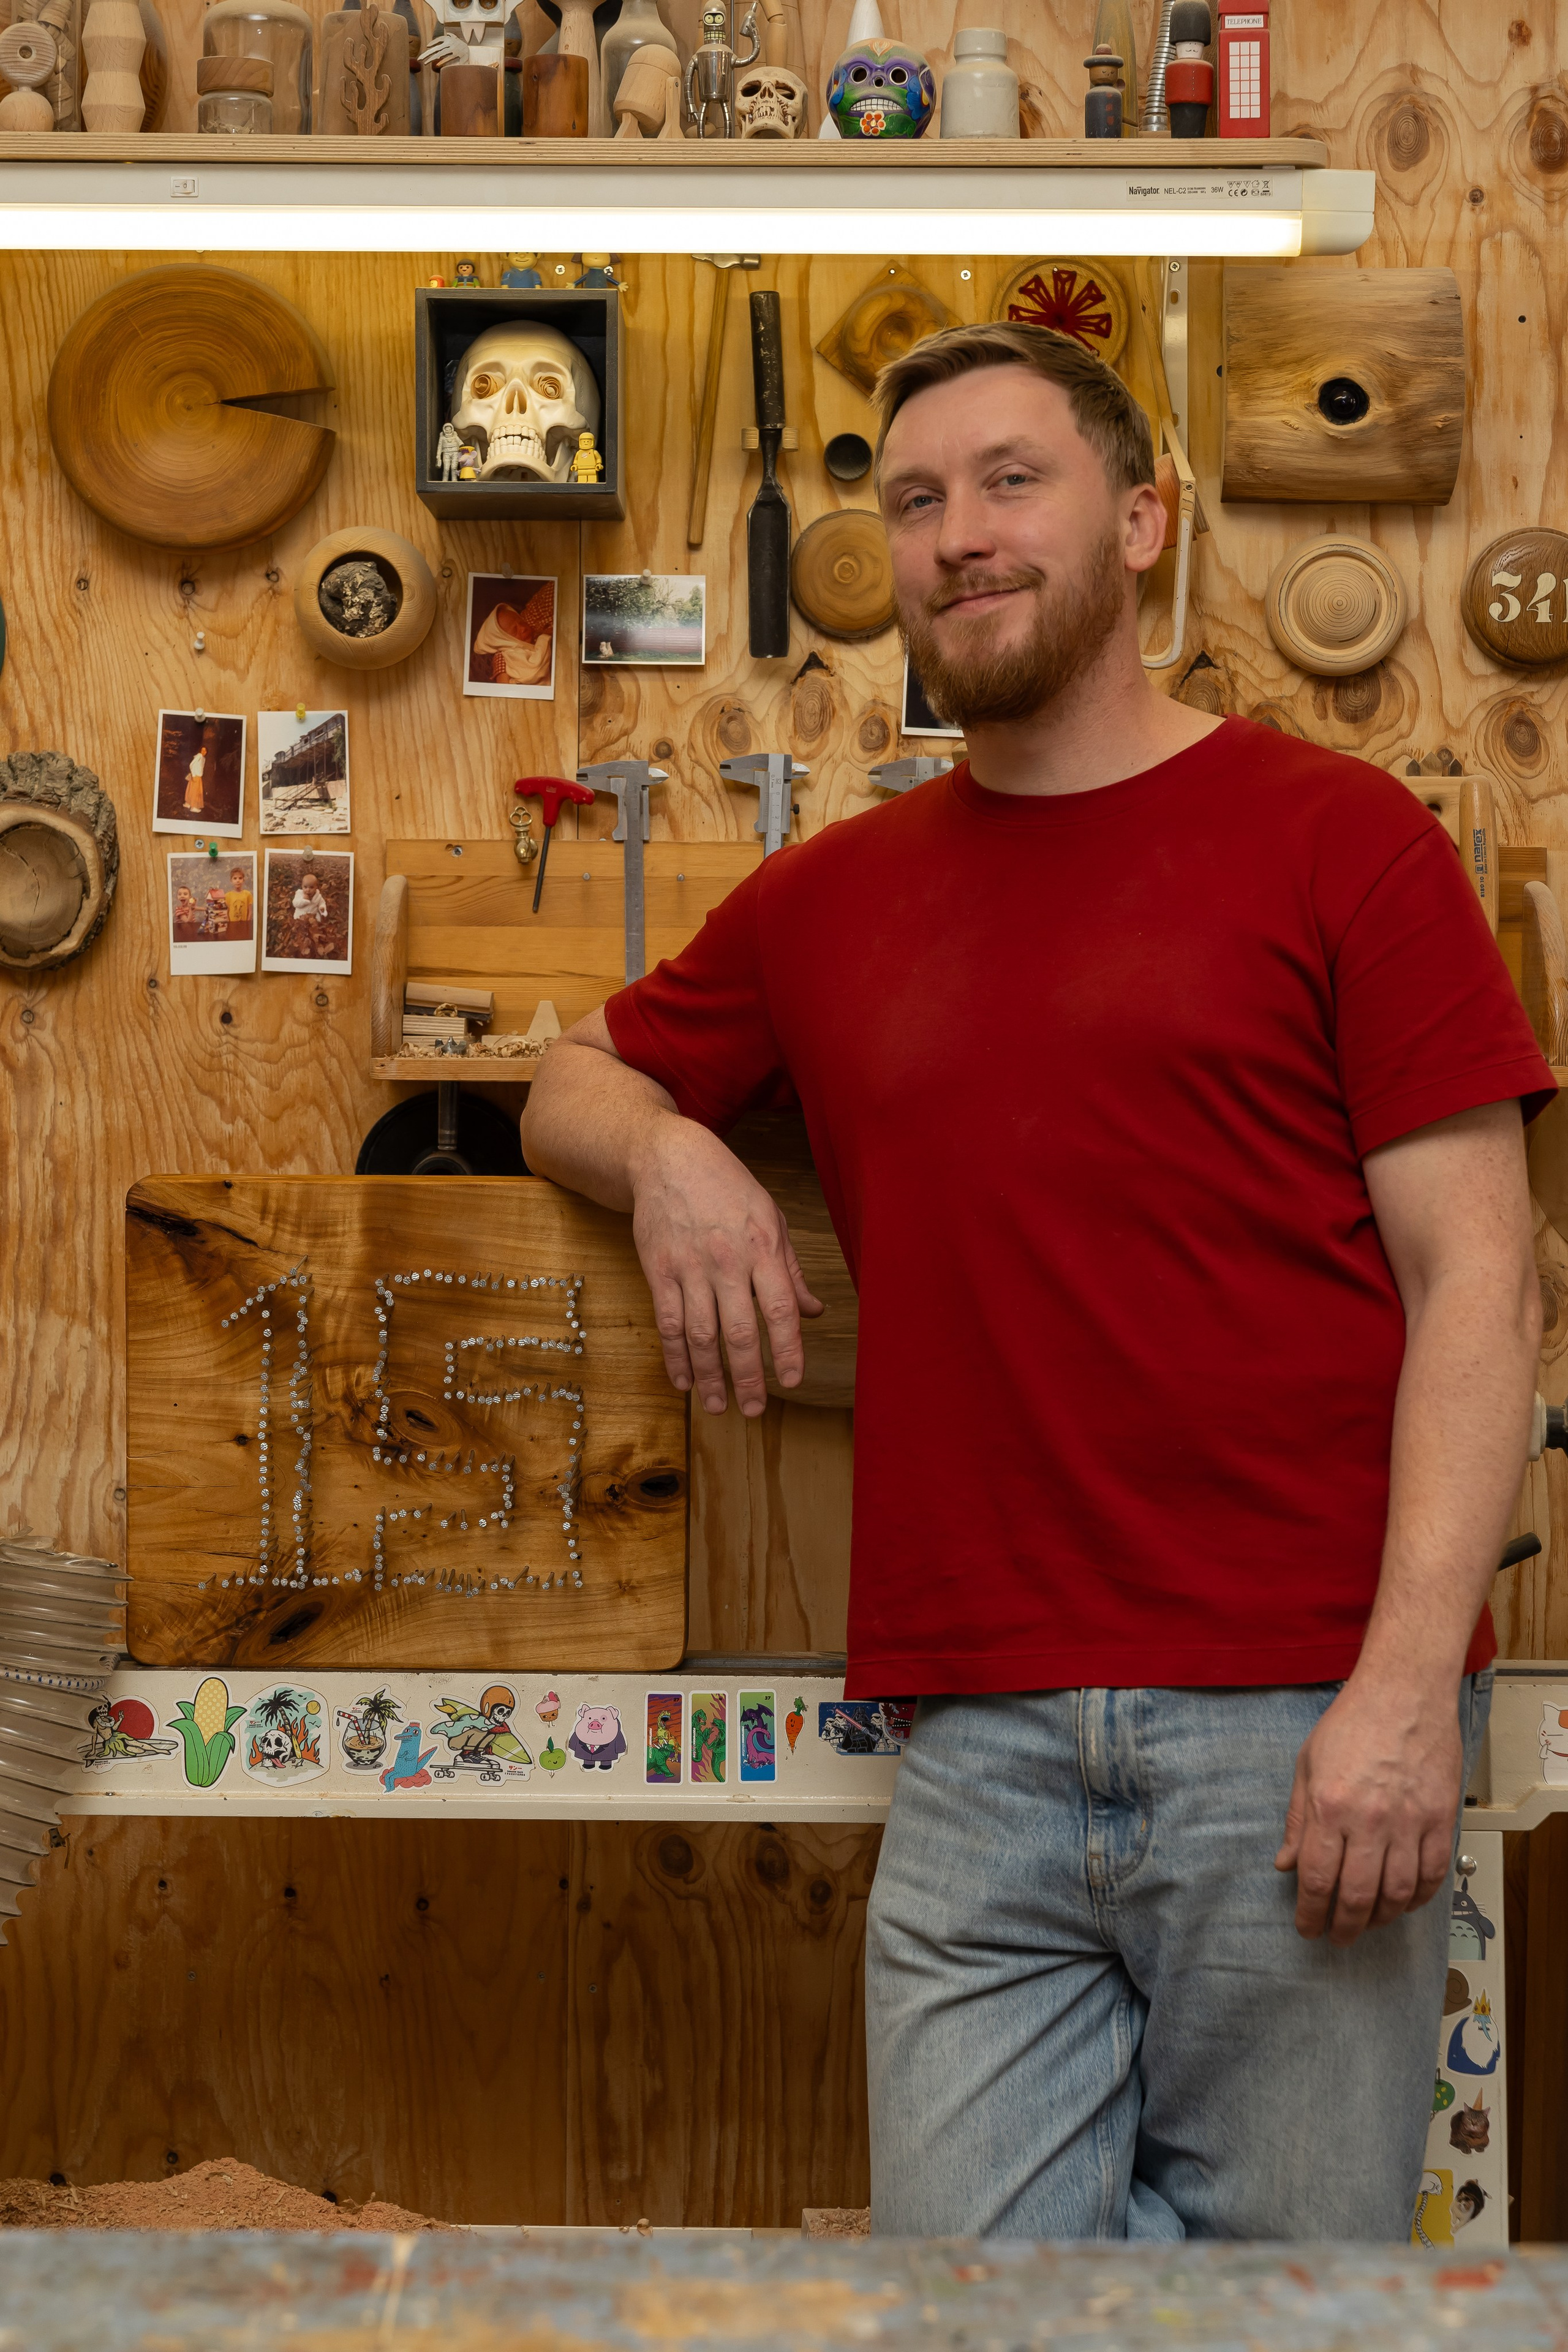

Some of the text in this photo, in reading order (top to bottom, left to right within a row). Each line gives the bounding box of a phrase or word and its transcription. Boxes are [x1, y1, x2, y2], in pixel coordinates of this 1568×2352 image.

[1129, 186, 1160, 197] Navigator
[1473, 829, 1483, 862] narex
[198, 1259, 586, 1596] 15
